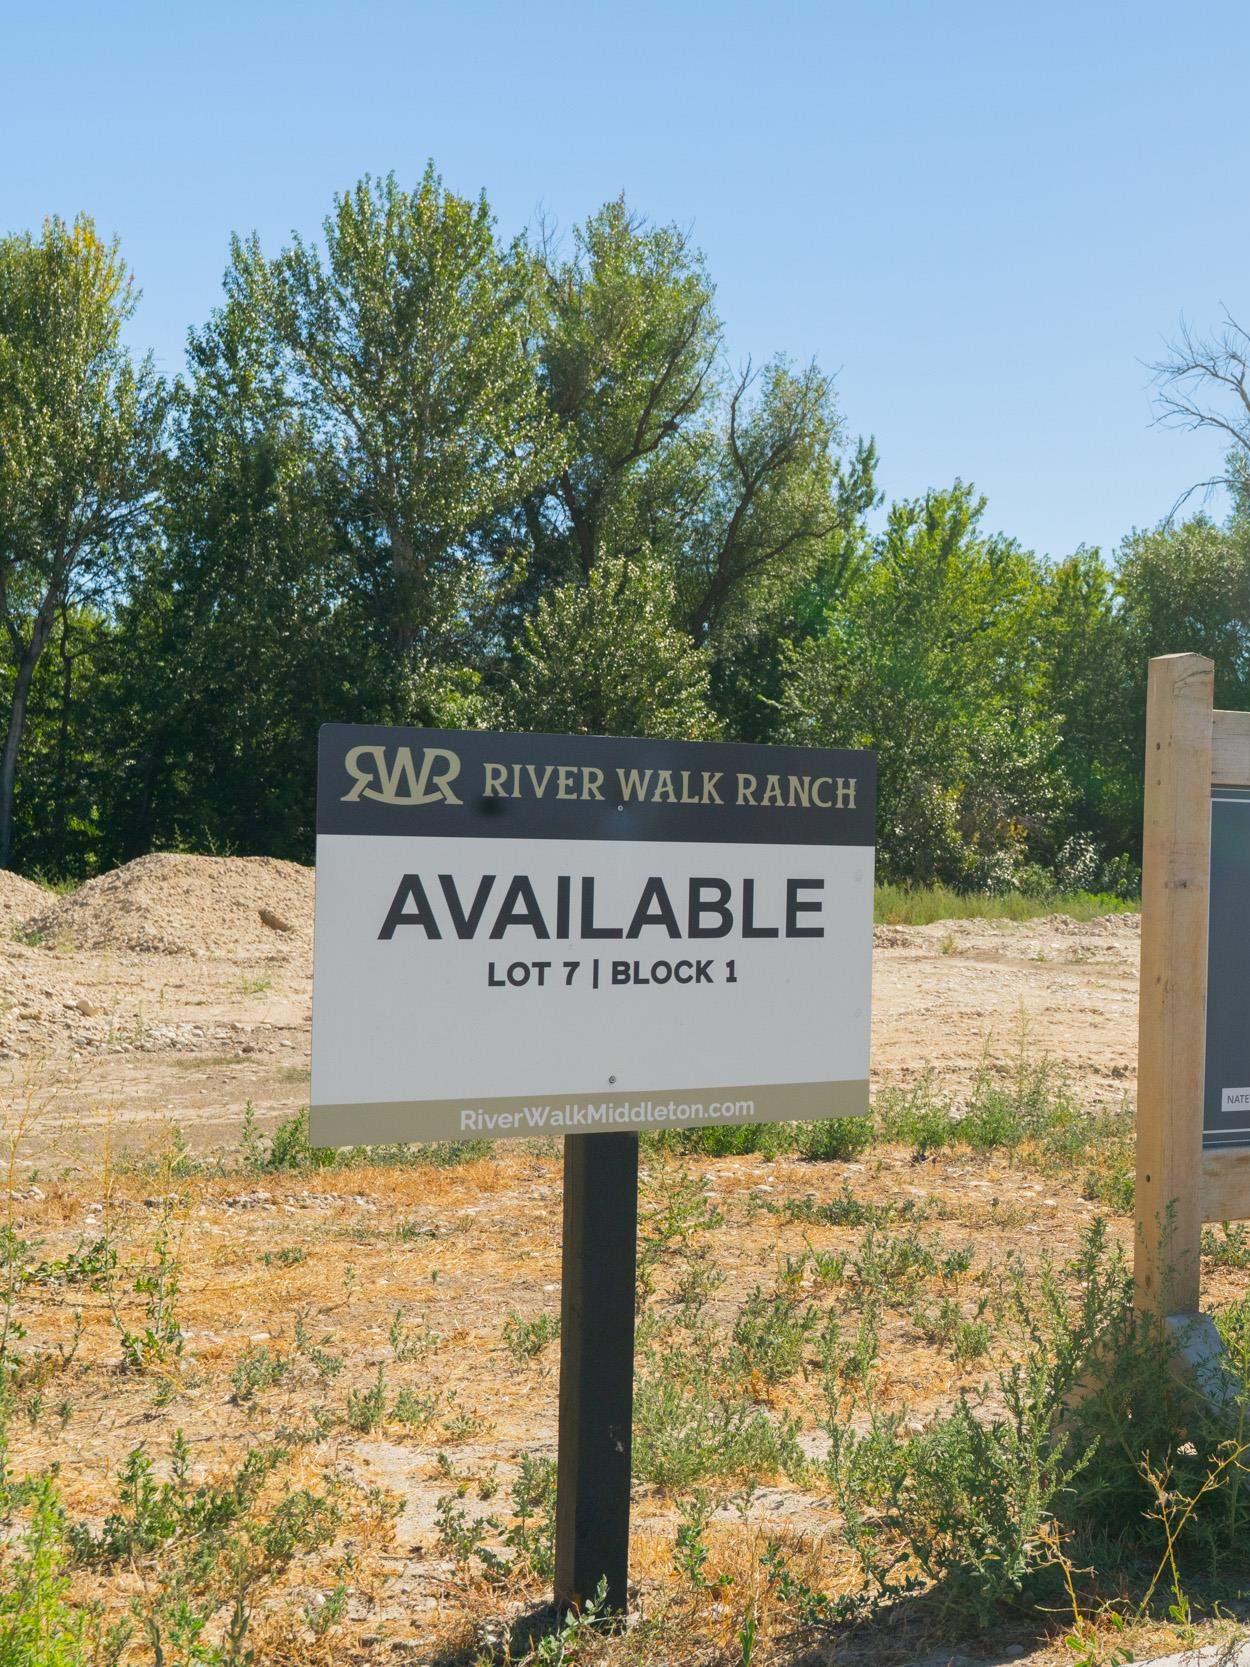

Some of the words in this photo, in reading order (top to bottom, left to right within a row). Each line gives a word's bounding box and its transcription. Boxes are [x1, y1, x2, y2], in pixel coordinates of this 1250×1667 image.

[483, 763, 605, 800] RIVER
[616, 768, 724, 804] WALK
[736, 773, 857, 809] RANCH
[377, 873, 825, 940] AVAILABLE
[488, 961, 551, 987] LOT
[563, 961, 580, 986] 7
[611, 960, 713, 986] BLOCK
[725, 960, 738, 983] 1
[459, 1099, 755, 1131] RiverWalkMiddleton.com
[1227, 1094, 1249, 1104] NATE
